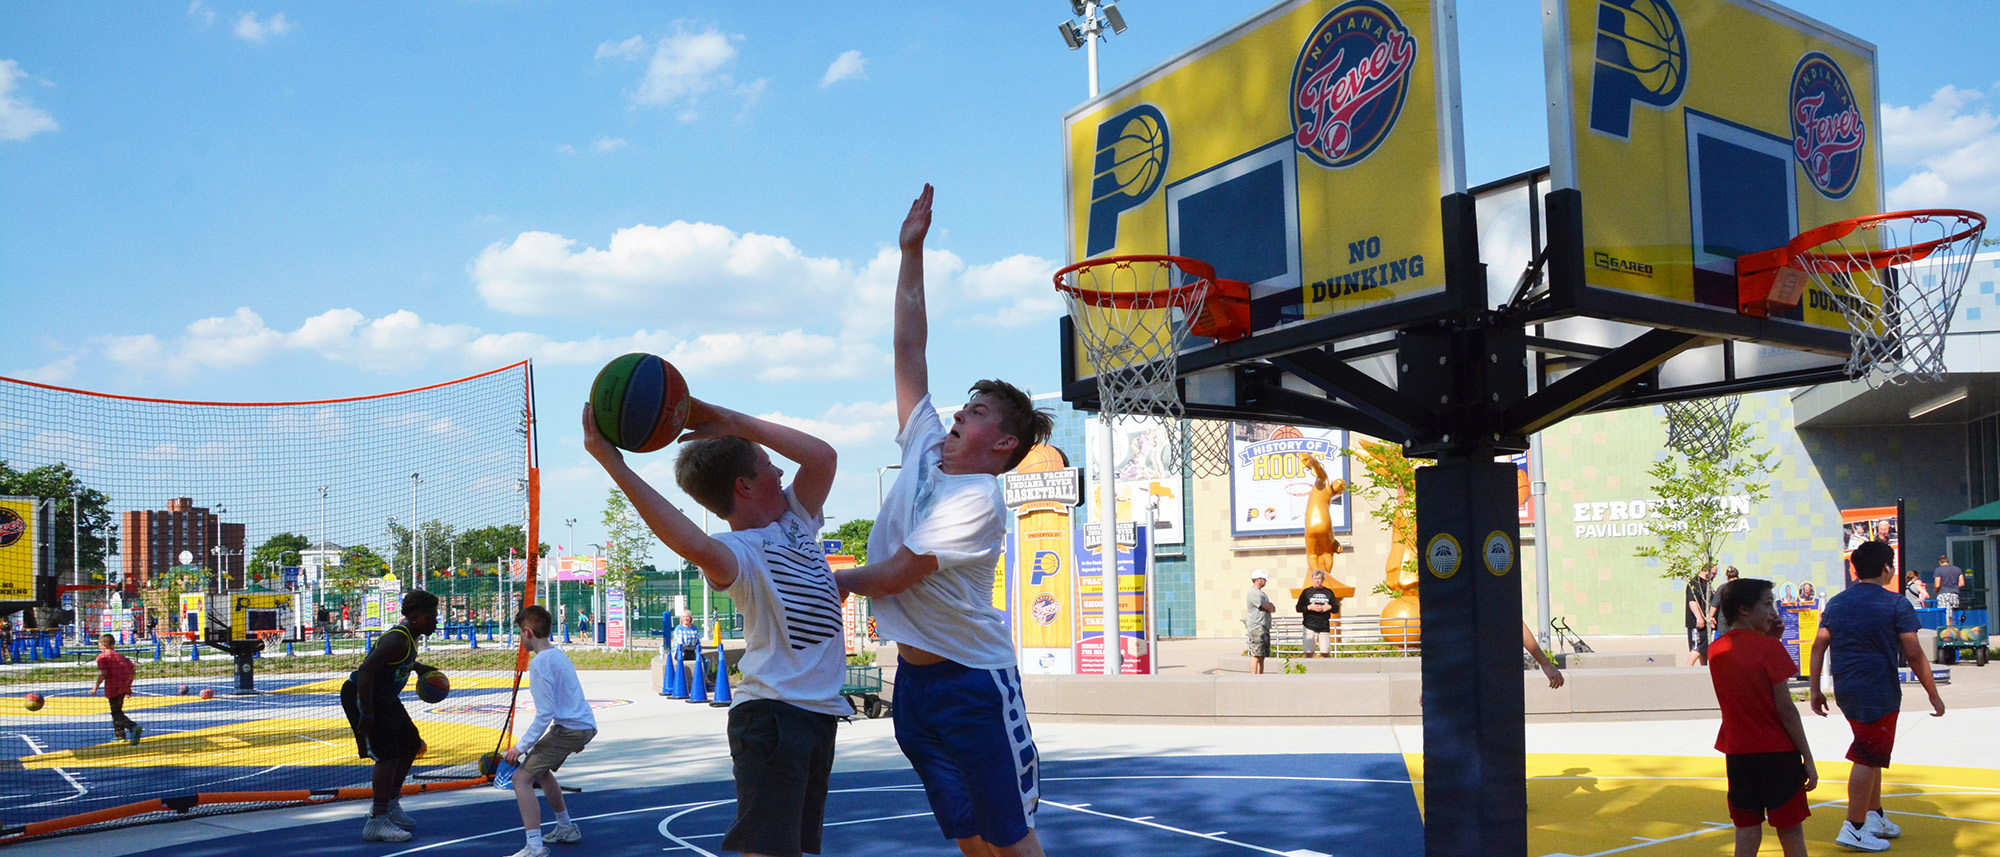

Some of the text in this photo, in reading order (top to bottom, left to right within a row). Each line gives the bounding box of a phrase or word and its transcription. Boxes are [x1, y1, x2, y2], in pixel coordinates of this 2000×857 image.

[1305, 17, 1384, 73] INDIANA
[1297, 29, 1412, 148] Fever
[1799, 68, 1848, 105] INDIANA
[1795, 91, 1863, 160] Fever
[1348, 235, 1381, 265] NO
[1610, 257, 1653, 274] GARED
[1311, 254, 1424, 304] DUNKING
[1253, 441, 1323, 456] HISTORY OF
[1007, 470, 1075, 483] INDIANA PACERS
[1009, 478, 1072, 489] INDIANA FEVER
[1006, 485, 1076, 504] BASKETBALL
[1575, 523, 1650, 539] PAVILION
